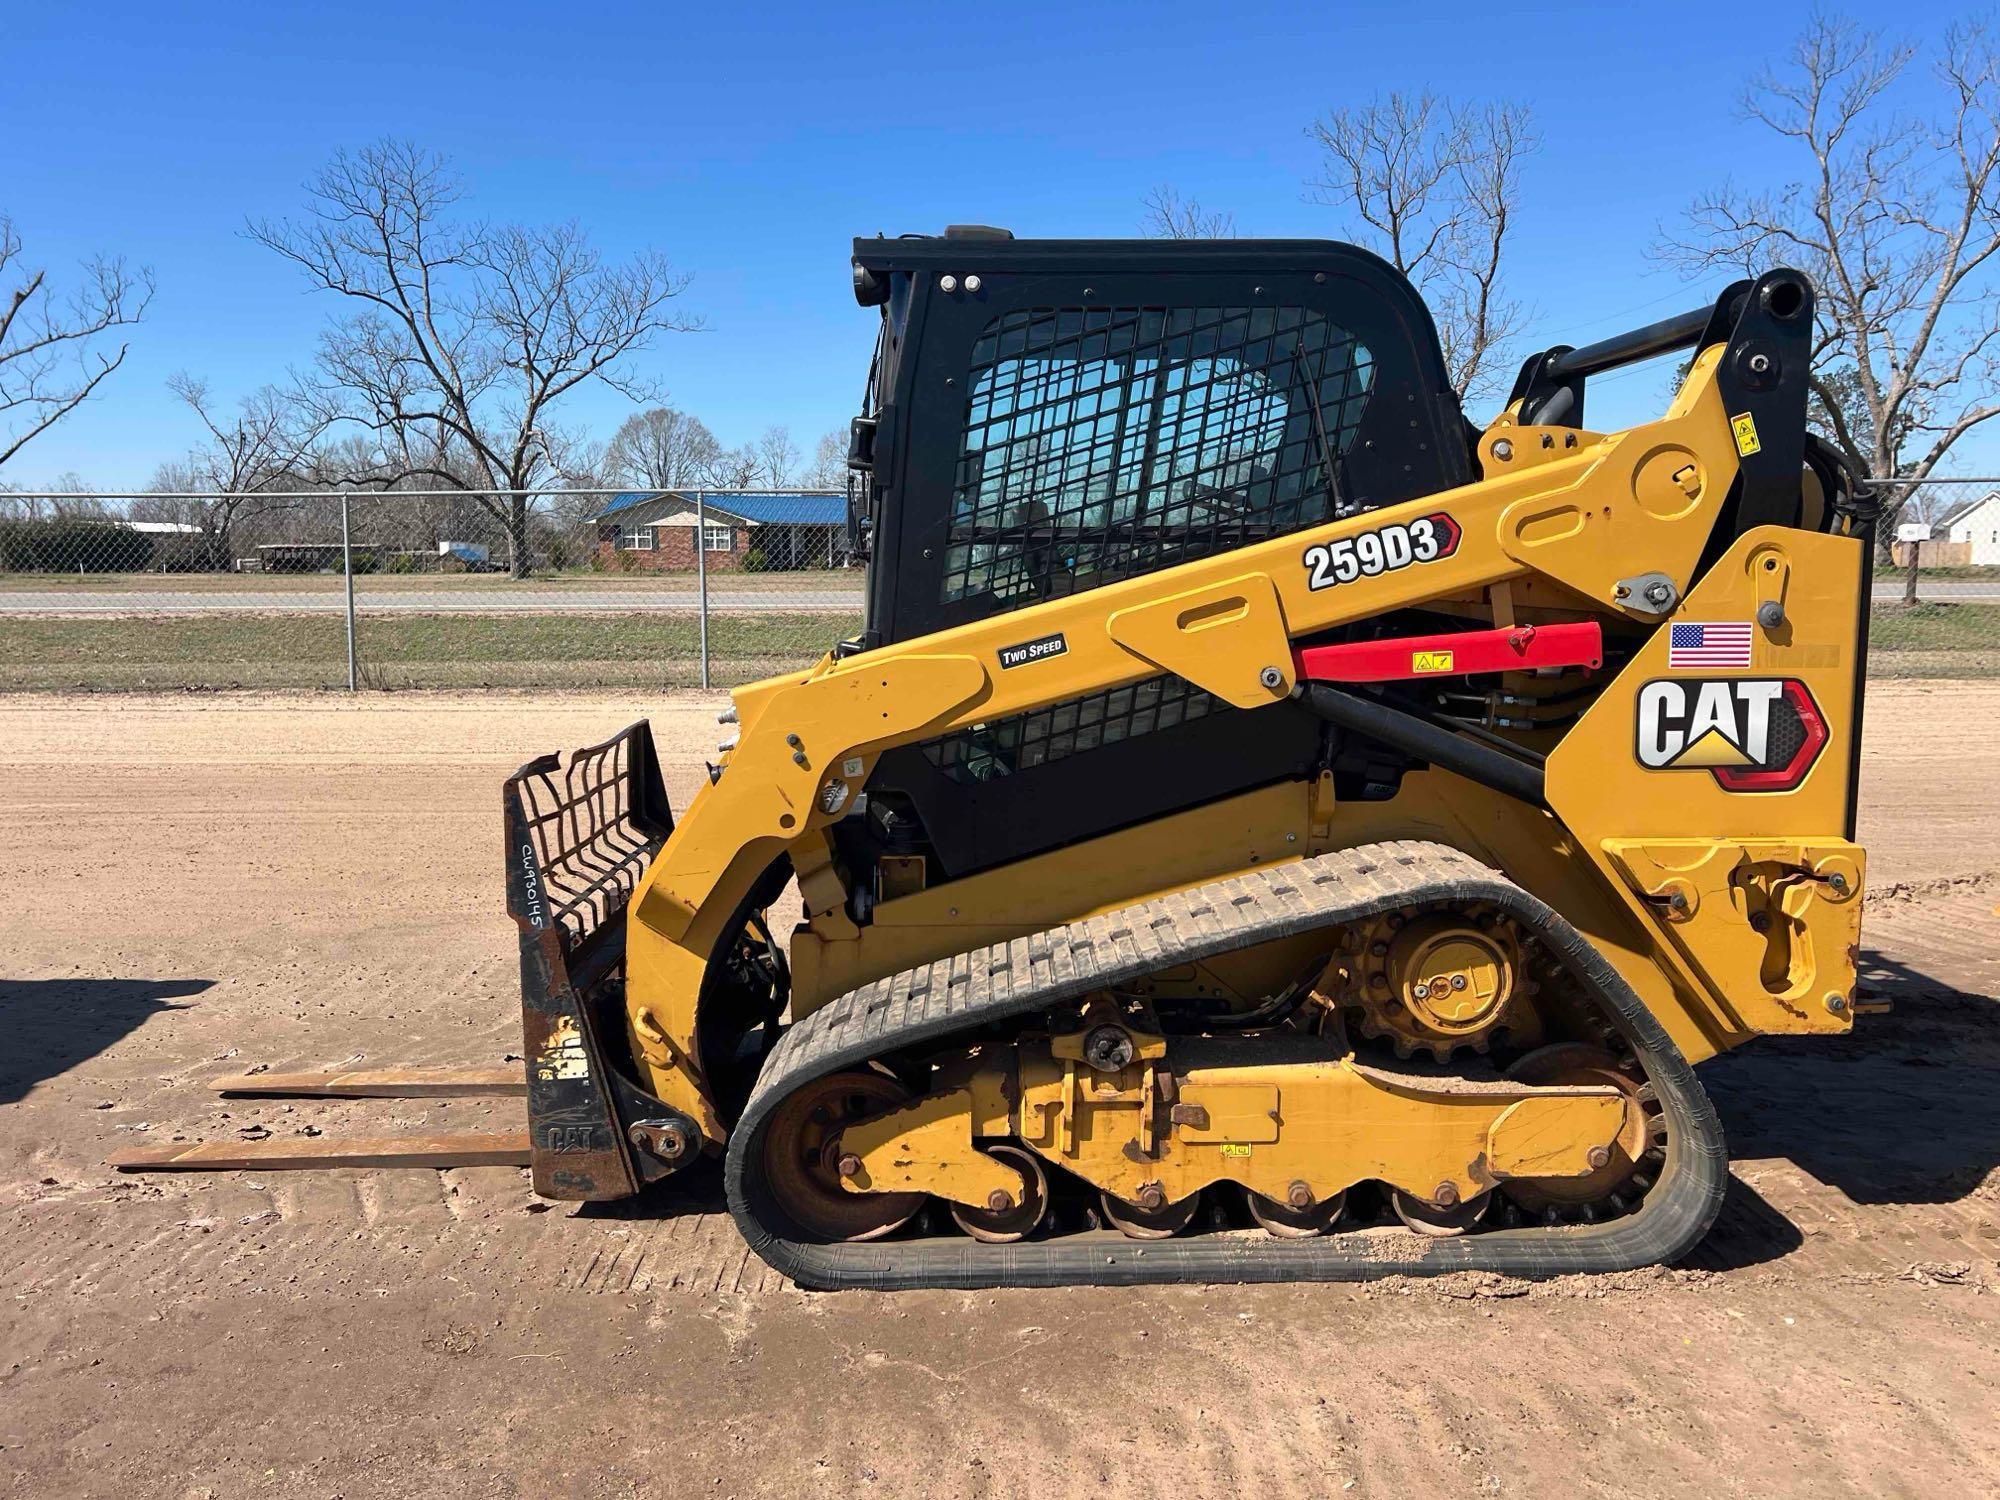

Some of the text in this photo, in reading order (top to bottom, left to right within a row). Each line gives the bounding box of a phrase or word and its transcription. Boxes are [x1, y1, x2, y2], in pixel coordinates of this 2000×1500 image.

[1304, 518, 1438, 590] 259D3
[1638, 680, 1783, 767] CAT
[522, 843, 543, 929] CW930145
[547, 1126, 594, 1155] CAT
